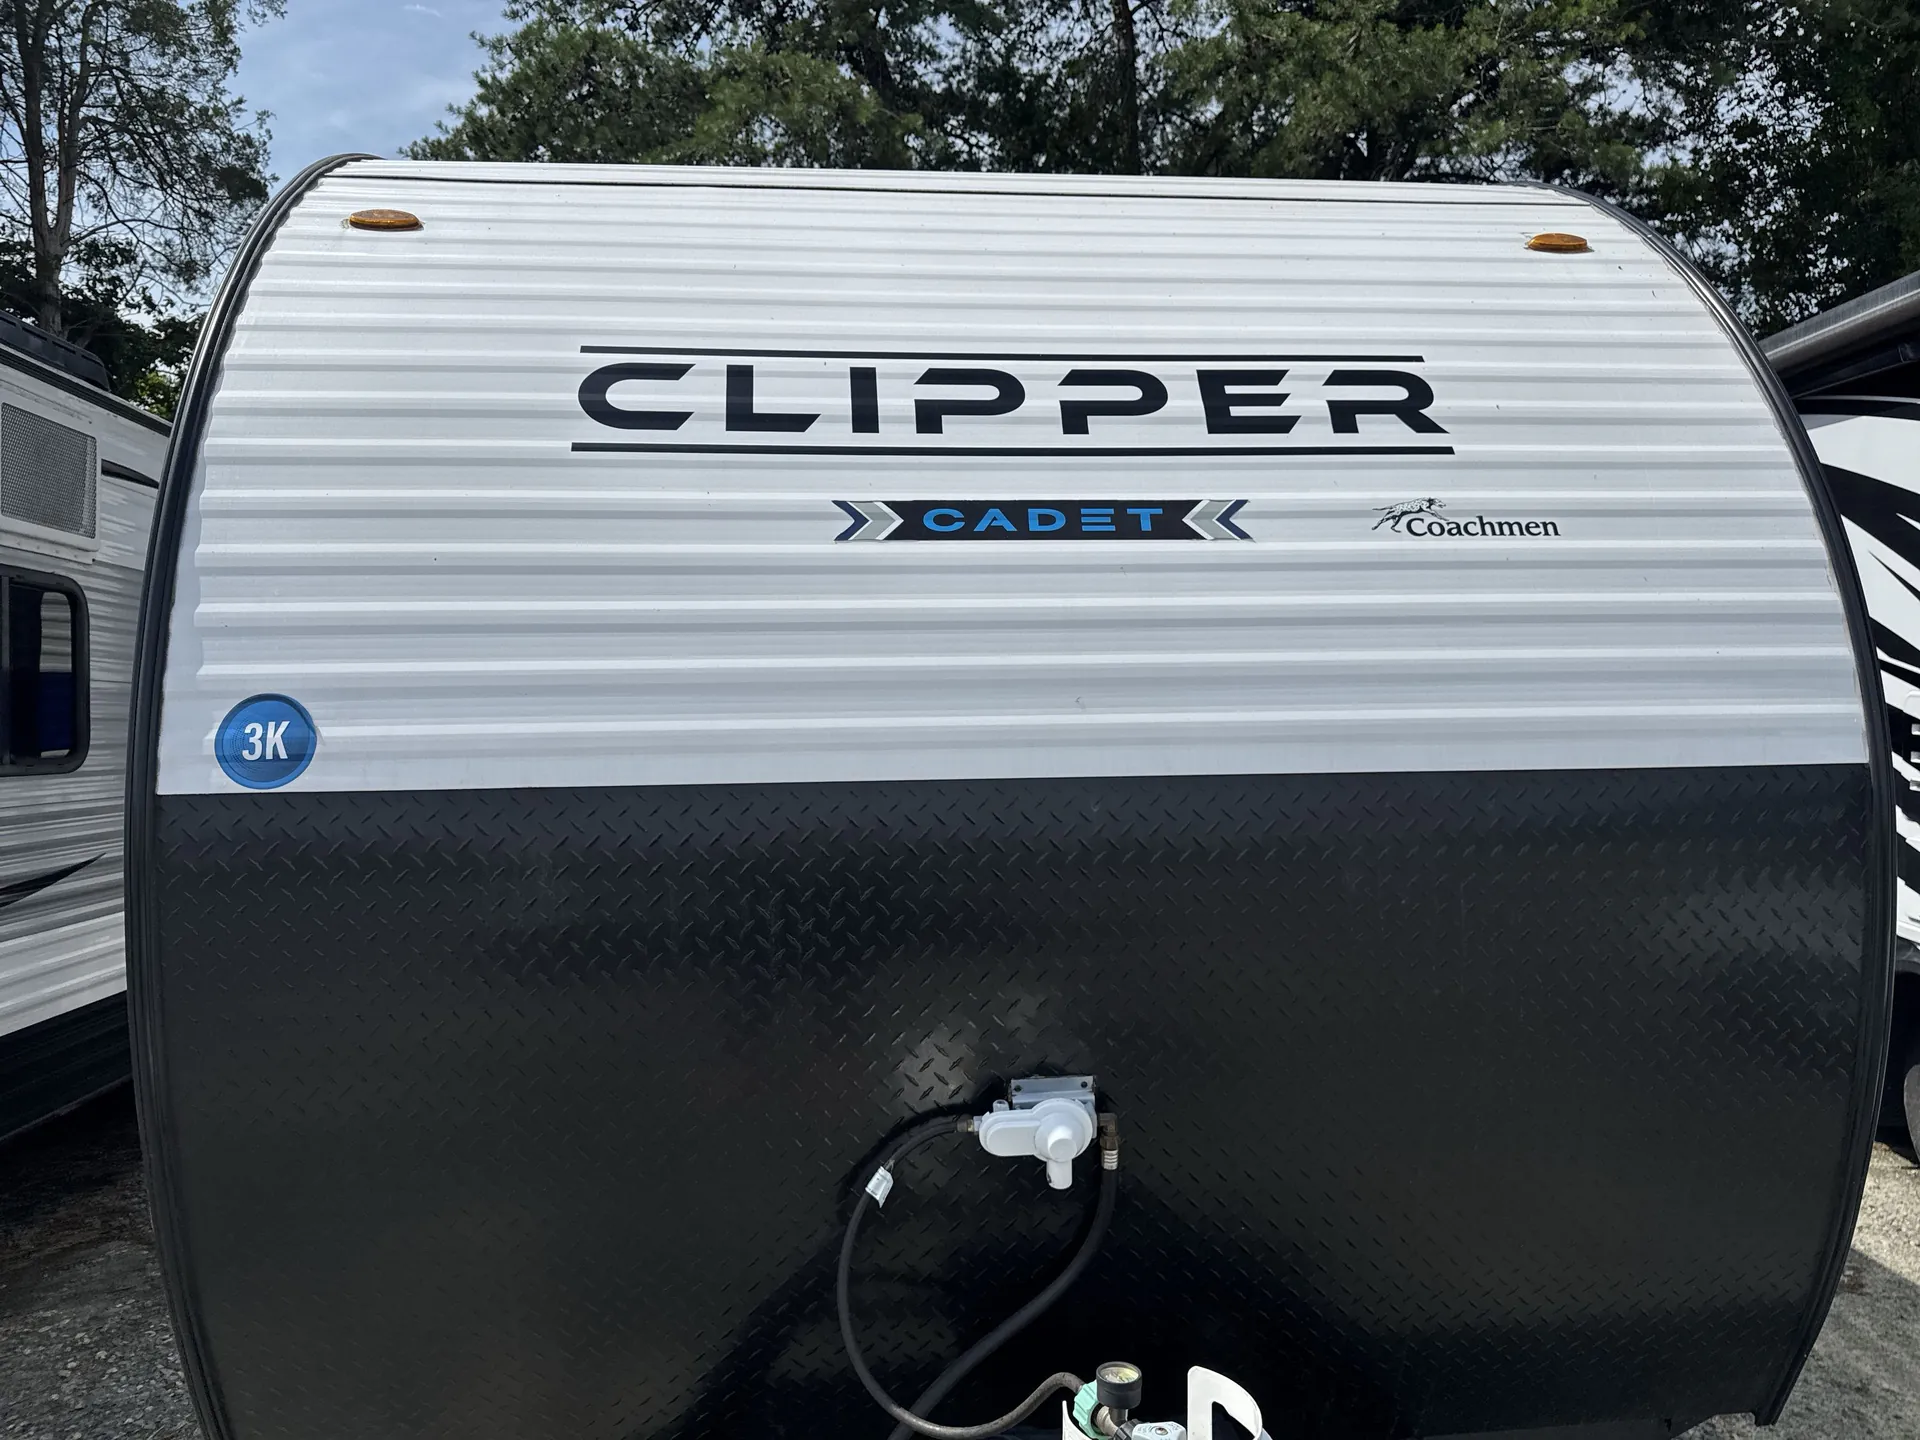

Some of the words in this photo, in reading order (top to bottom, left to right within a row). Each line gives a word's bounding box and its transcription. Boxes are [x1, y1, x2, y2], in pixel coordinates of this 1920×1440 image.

[577, 362, 1450, 435] CLIPPER
[922, 507, 1163, 532] CADET
[1406, 515, 1561, 537] Coachmen
[242, 720, 290, 761] 3K
